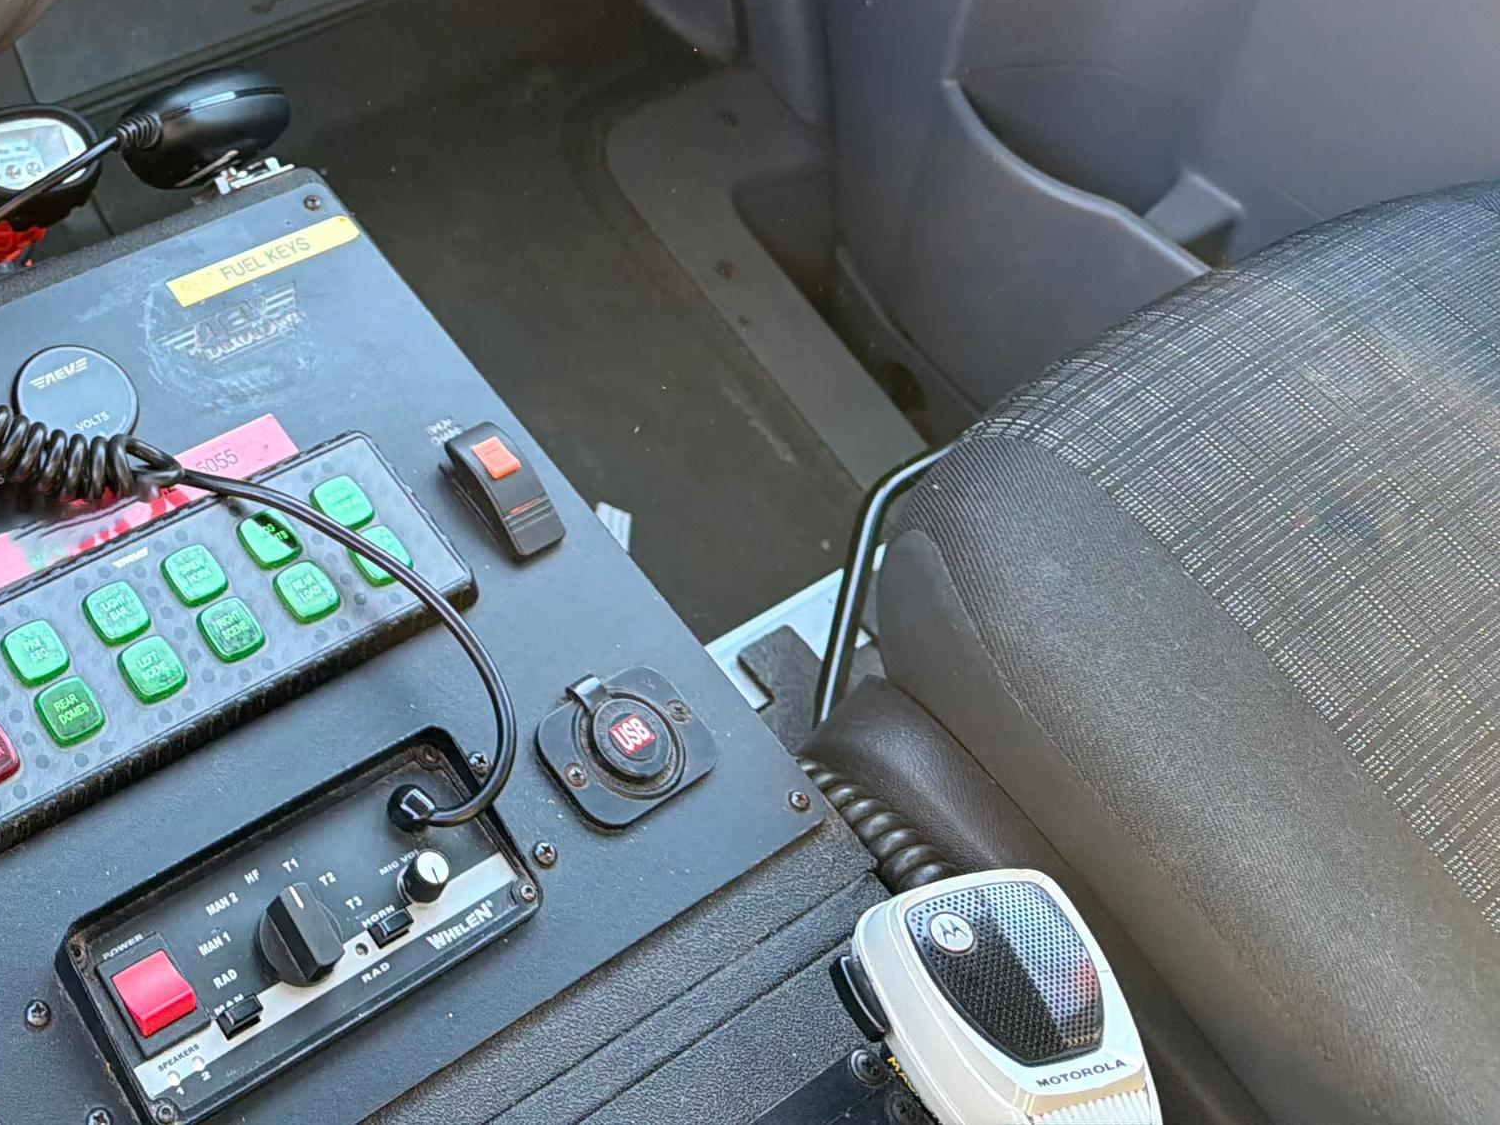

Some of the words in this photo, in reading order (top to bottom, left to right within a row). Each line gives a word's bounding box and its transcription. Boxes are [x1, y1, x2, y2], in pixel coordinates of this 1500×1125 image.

[220, 257, 267, 281] FUEL
[265, 237, 311, 264] KEYS
[75, 411, 111, 431] VOLTS
[137, 651, 159, 668] LEFT
[53, 692, 79, 713] REAR
[58, 702, 90, 725] DOMES
[611, 717, 651, 752] USB
[282, 857, 299, 874] T1
[379, 861, 400, 876] MIC
[243, 869, 261, 885] HF
[318, 871, 337, 887] T2
[205, 895, 231, 917] MAN
[229, 891, 239, 904] 2
[345, 895, 363, 910] T3
[361, 904, 395, 929] HORN
[102, 933, 145, 961] POWER
[198, 935, 224, 957] MAN
[222, 931, 232, 943] 1
[212, 969, 238, 990] RAD
[361, 962, 391, 984] RAD
[157, 1043, 201, 1072] SPEAKERS
[200, 1070, 212, 1082] 2
[1036, 1058, 1128, 1088] MOTOROLA
[176, 1086, 185, 1096] 1
